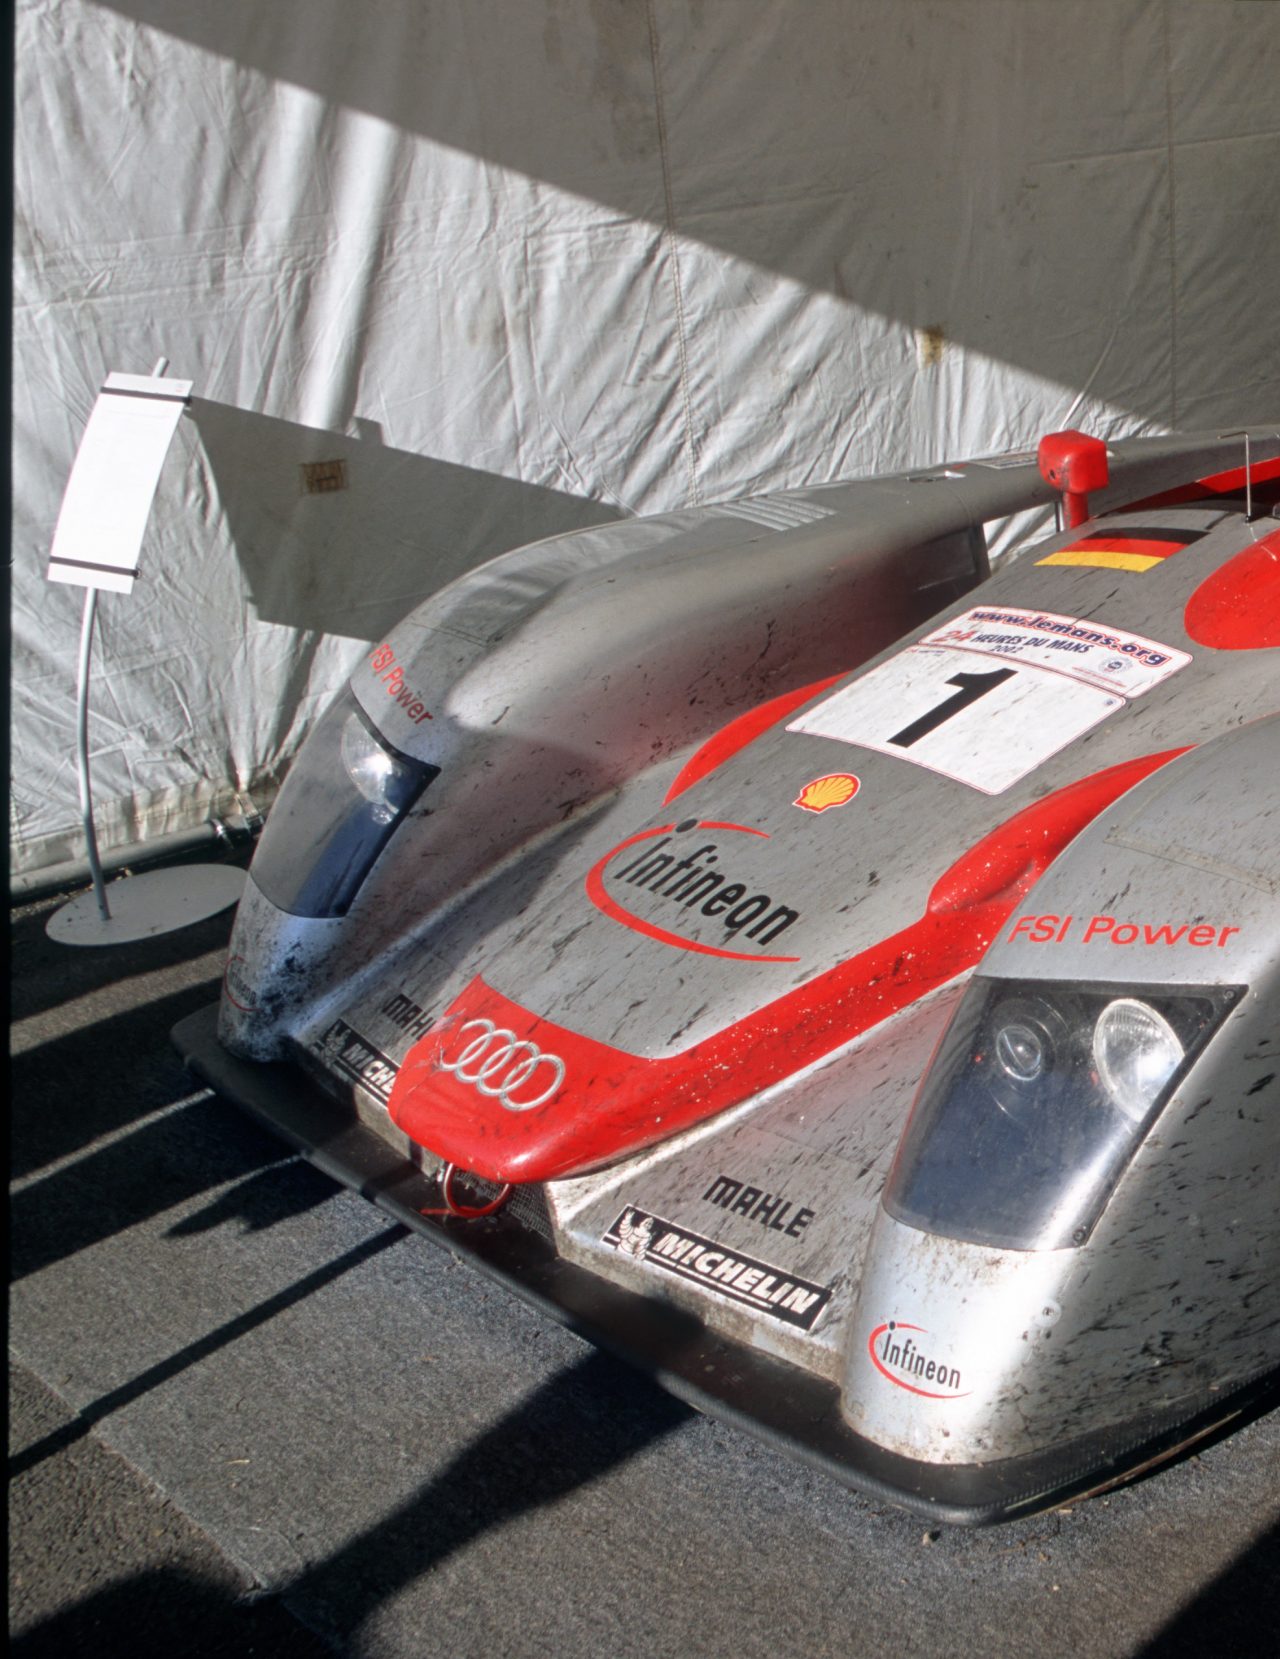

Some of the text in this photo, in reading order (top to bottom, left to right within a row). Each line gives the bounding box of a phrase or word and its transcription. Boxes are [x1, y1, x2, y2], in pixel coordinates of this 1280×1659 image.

[931, 629, 1096, 654] 24 HEURES DU MANS
[969, 609, 1173, 668] www.lemans.org
[368, 642, 434, 725] FSI Power
[886, 667, 1019, 749] 1
[1007, 914, 1242, 948] FSI Power
[381, 992, 438, 1042] MAHL
[702, 1175, 817, 1239] MAHLE
[652, 1231, 821, 1315] MICHELIN
